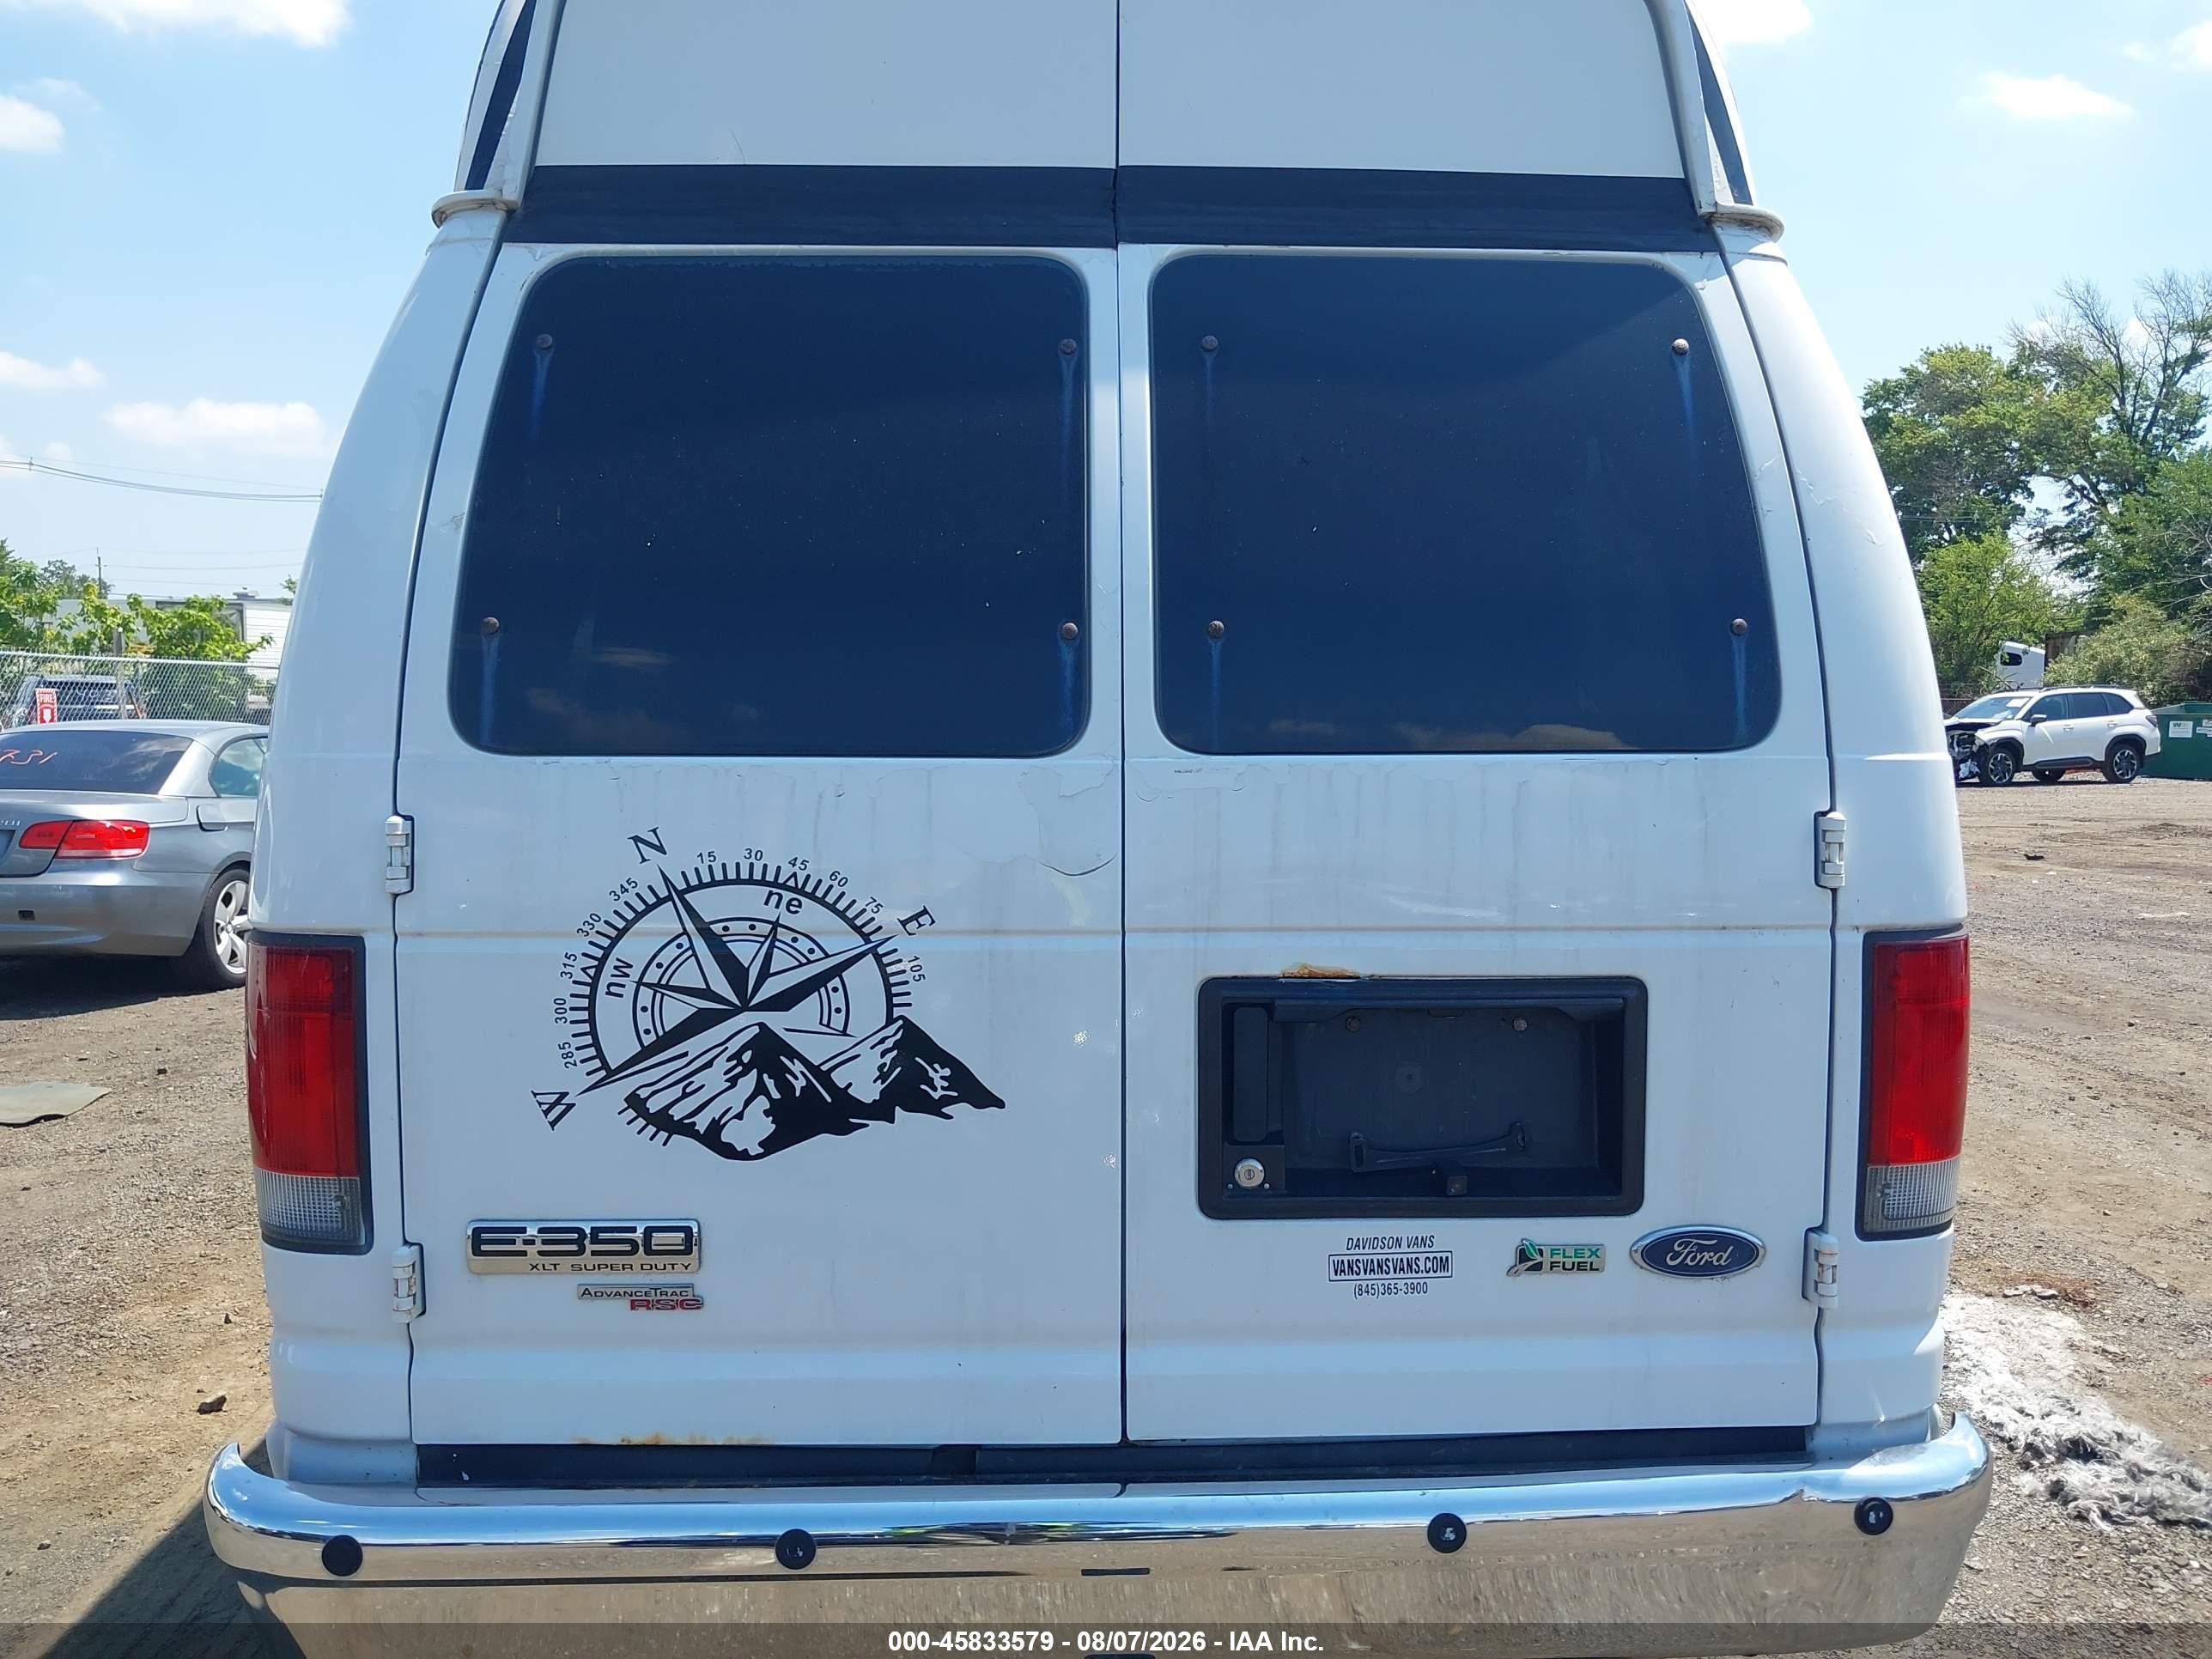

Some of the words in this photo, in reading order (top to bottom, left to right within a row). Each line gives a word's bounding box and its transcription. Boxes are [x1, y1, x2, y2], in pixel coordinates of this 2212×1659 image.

[39, 693, 55, 703] FIRE
[627, 826, 668, 865] N
[696, 850, 718, 864] 15
[744, 848, 763, 862] 30
[787, 856, 810, 872] 45
[609, 877, 639, 902] 345
[829, 870, 849, 888] 60
[763, 889, 803, 915] ne
[865, 896, 884, 915] 75
[576, 912, 602, 937] 330
[896, 905, 936, 937] E
[560, 951, 578, 980] 315
[907, 955, 927, 982] 105
[605, 957, 634, 999] nw
[553, 997, 568, 1024] 300
[558, 1041, 578, 1069] 285
[531, 1090, 576, 1131] W
[471, 1225, 694, 1257] E-350
[1346, 1236, 1403, 1251] DAVIDSON
[1407, 1234, 1436, 1249] VANS
[1666, 1237, 1735, 1267] Ford
[1549, 1248, 1601, 1259] FLEX
[528, 1263, 560, 1272] XLT
[570, 1262, 634, 1272] SUPER
[640, 1262, 692, 1271] DUTY
[1332, 1255, 1450, 1277] VANSVANSVANS.COM
[1549, 1261, 1601, 1272] FUEL
[1353, 1281, 1429, 1300] (845)365-3900
[629, 1298, 703, 1311] RSC
